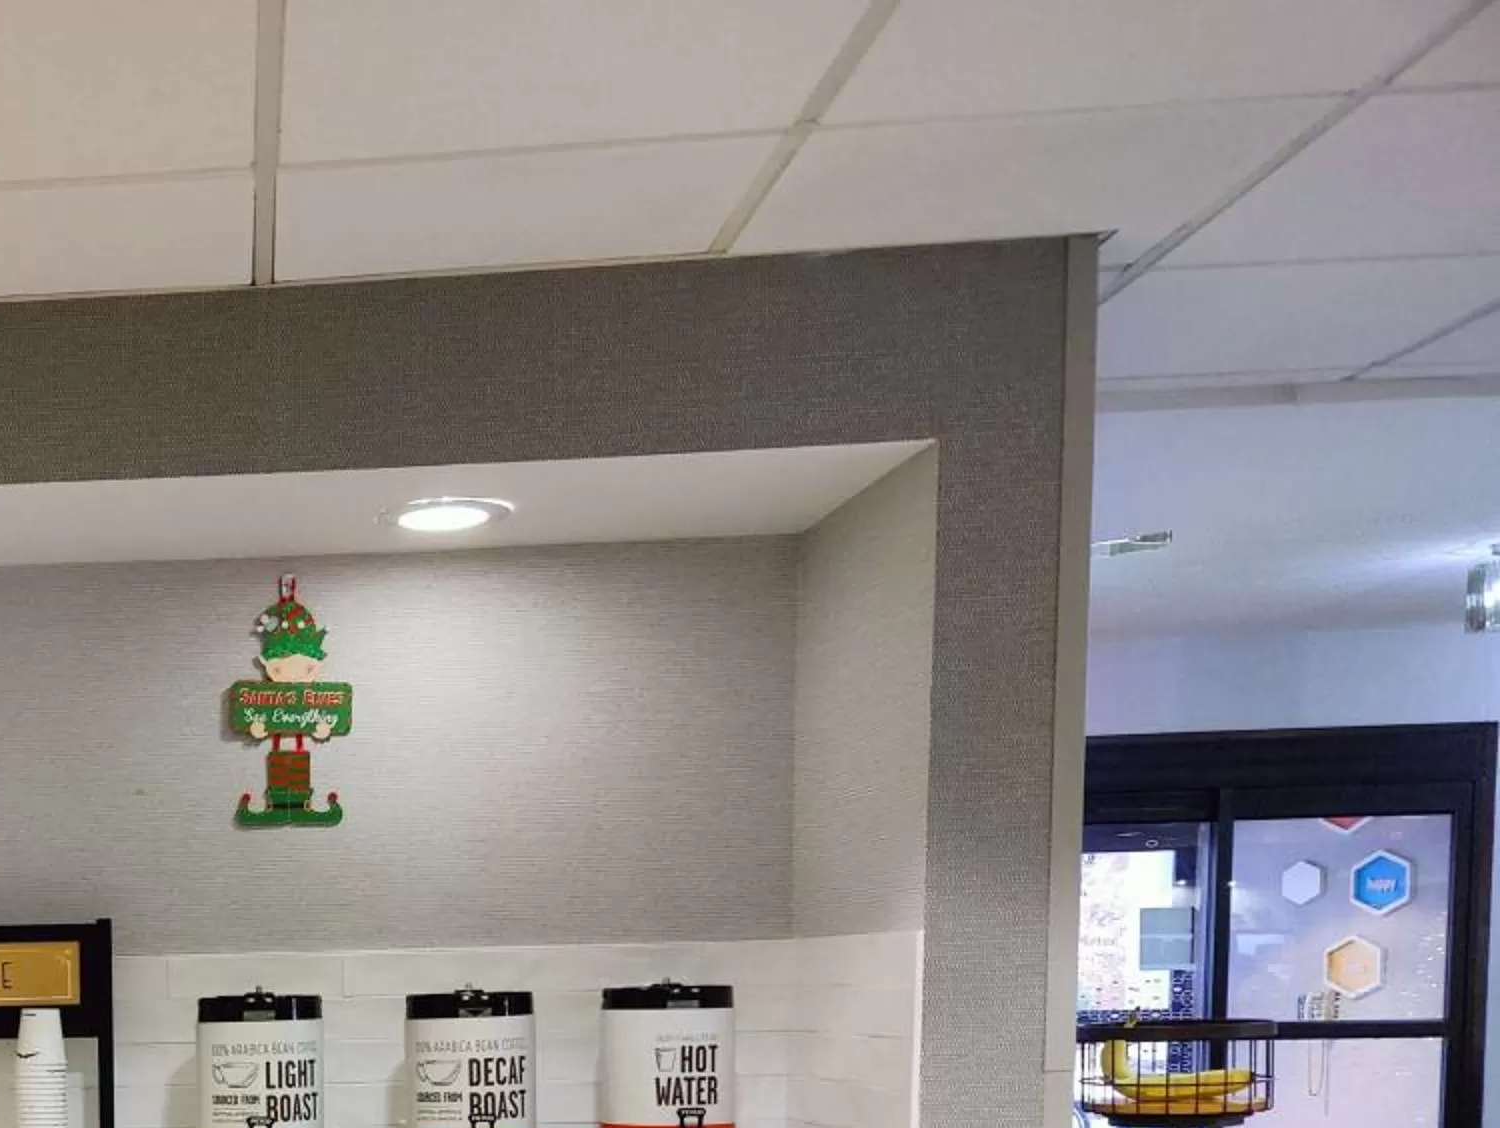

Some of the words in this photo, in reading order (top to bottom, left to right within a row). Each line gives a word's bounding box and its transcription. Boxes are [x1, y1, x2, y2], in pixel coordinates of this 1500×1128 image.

[468, 1055, 526, 1087] DECAF
[681, 1044, 719, 1073] HOT
[265, 1059, 316, 1089] LIGHT
[469, 1088, 526, 1120] ROAST
[655, 1076, 719, 1107] WATER
[266, 1092, 318, 1122] ROAST
